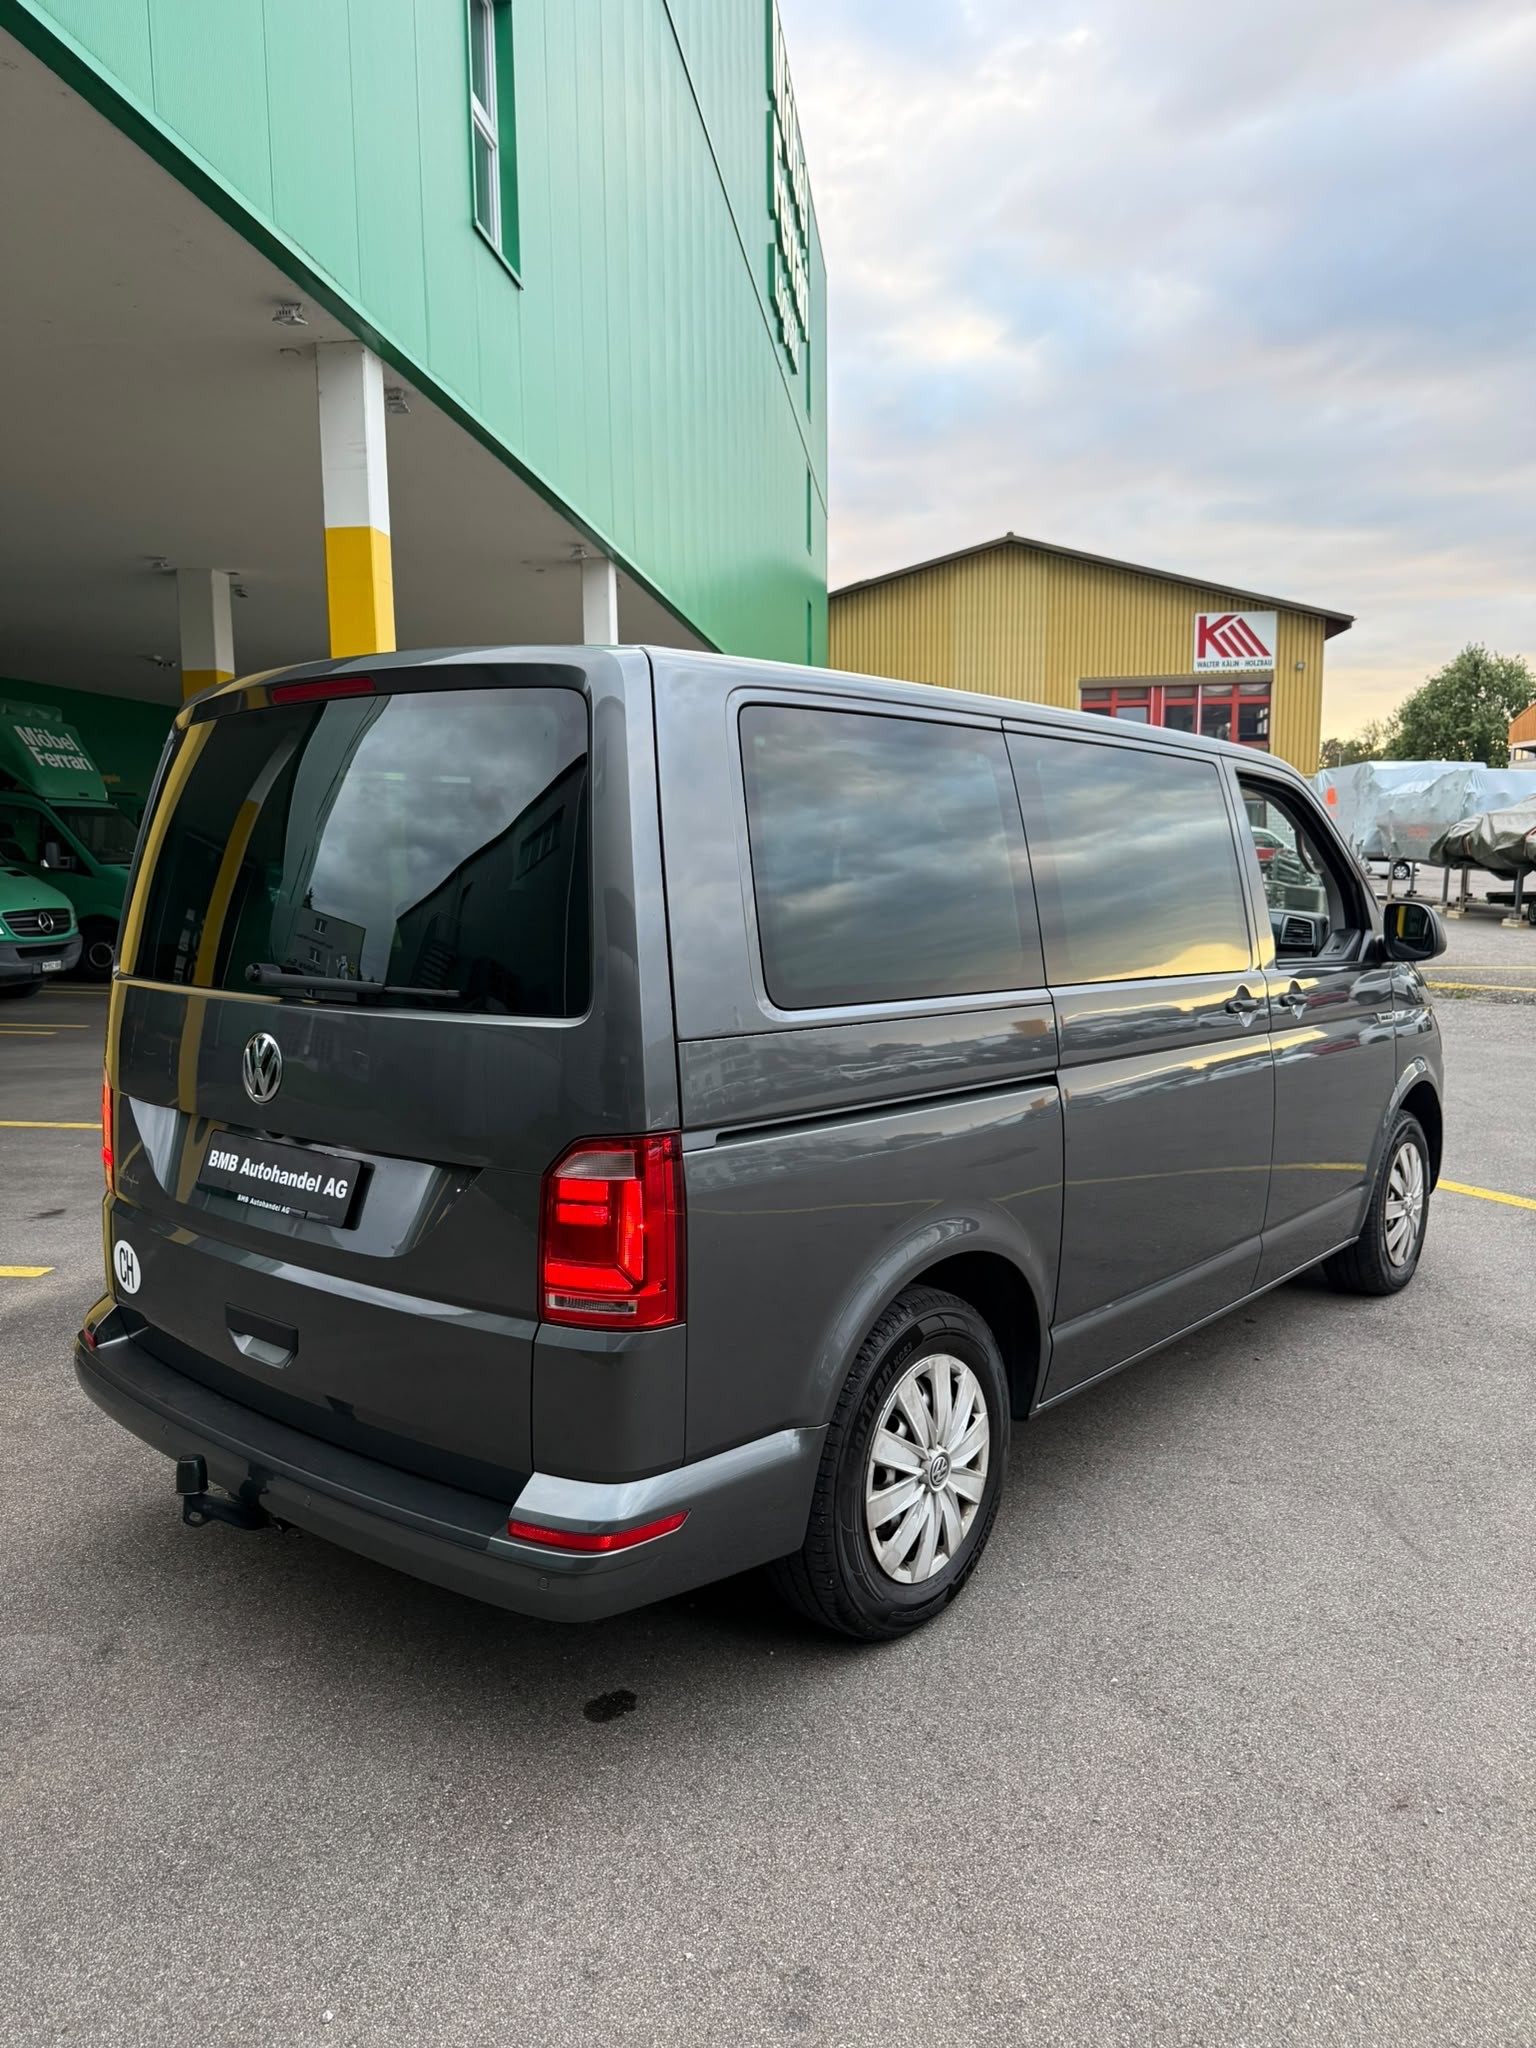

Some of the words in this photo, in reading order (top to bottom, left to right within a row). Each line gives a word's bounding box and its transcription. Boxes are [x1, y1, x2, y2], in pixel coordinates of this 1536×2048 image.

[773, 0, 809, 250] Möbel
[1244, 659, 1272, 667] HOLZBAU
[13, 725, 80, 752] Möbel
[28, 746, 94, 771] Ferrari
[207, 1150, 239, 1172] BMB
[239, 1158, 322, 1193] Autohandel
[322, 1177, 348, 1199] AG
[237, 1194, 249, 1203] BMB
[249, 1197, 281, 1212] Autohandel
[280, 1206, 291, 1215] AG
[119, 1246, 135, 1289] CH
